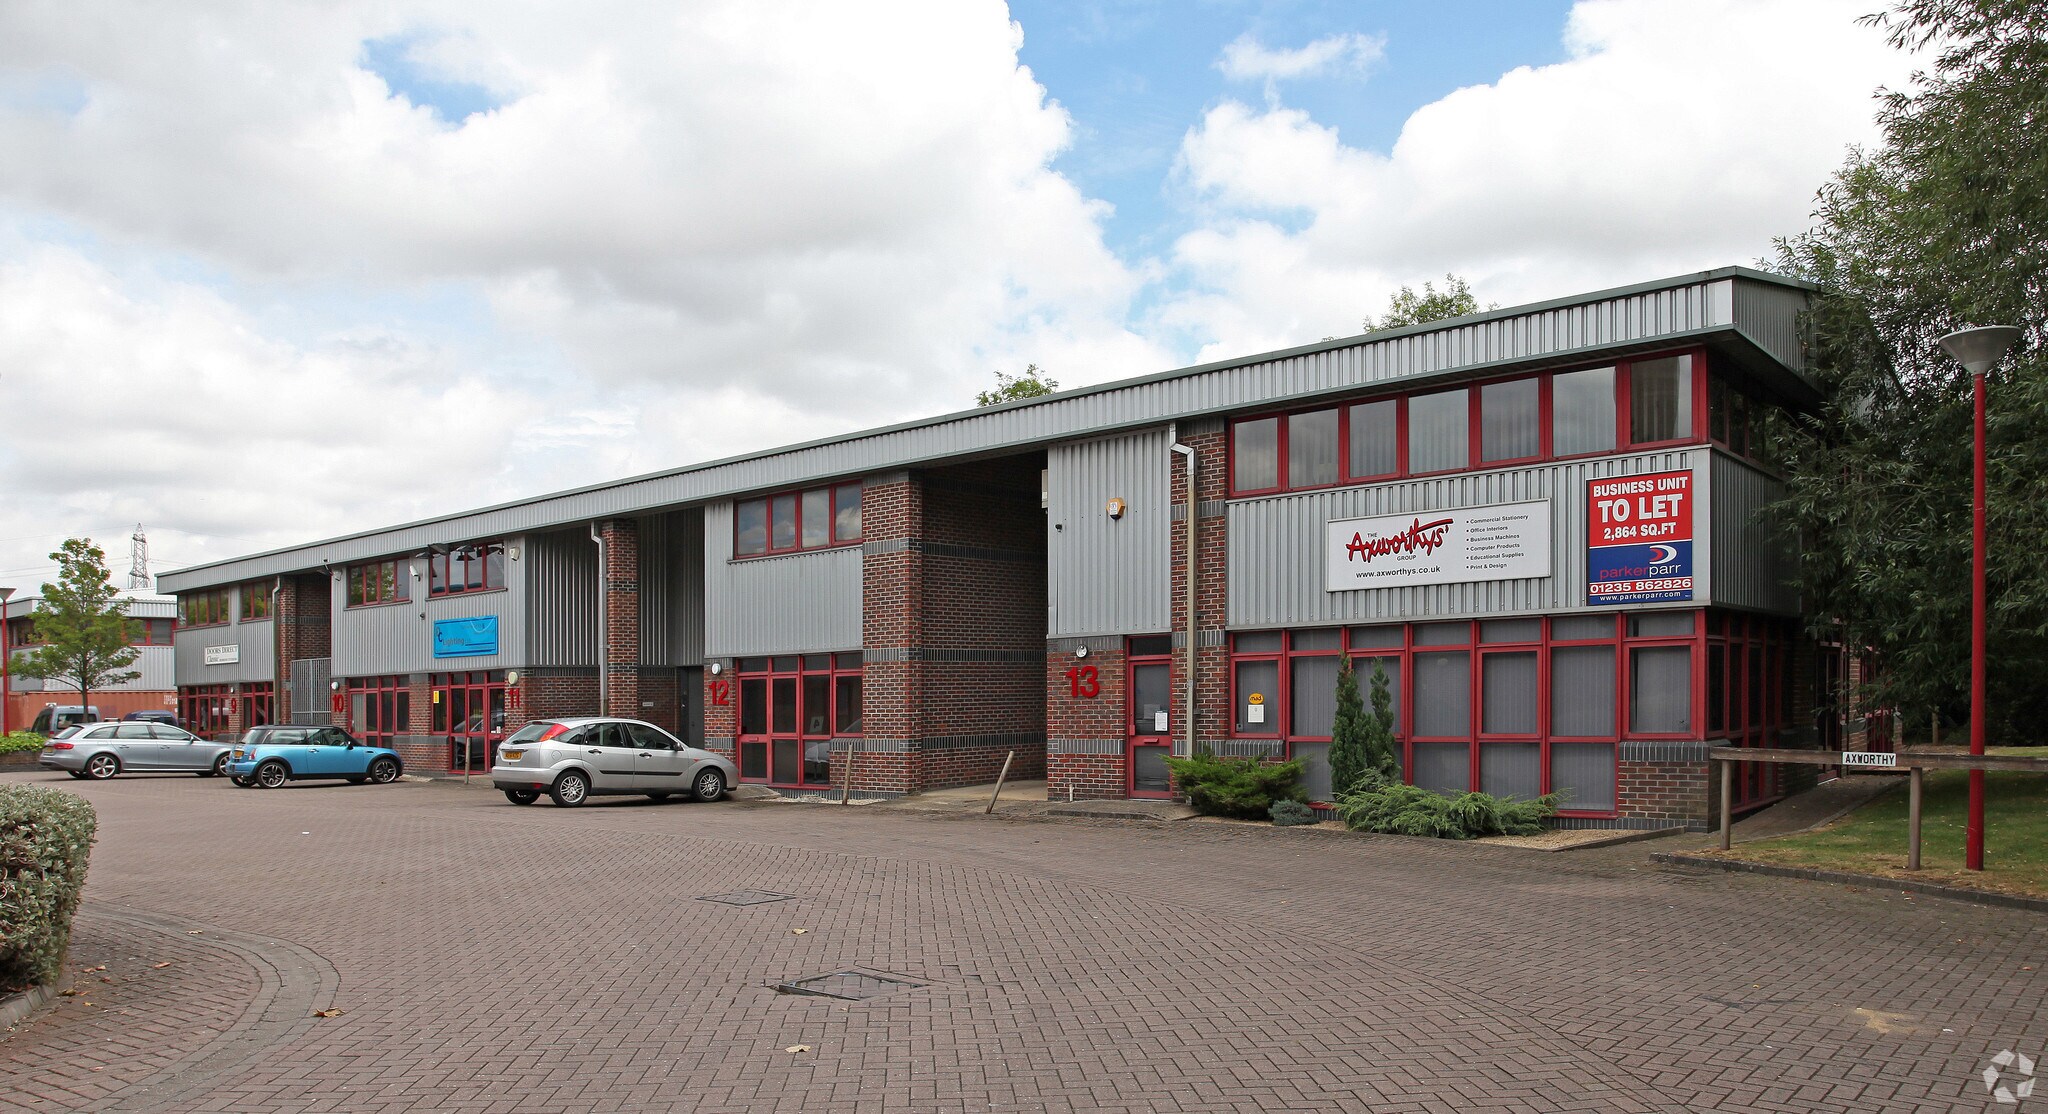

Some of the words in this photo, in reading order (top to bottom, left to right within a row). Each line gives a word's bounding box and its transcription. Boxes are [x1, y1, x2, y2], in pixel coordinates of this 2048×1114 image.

[1593, 480, 1654, 498] BUSINESS
[1657, 476, 1688, 491] UNIT
[1598, 498, 1631, 523] TO
[1638, 493, 1683, 520] LET
[1603, 526, 1637, 541] 2,864
[1640, 522, 1677, 537] SQ.FT
[1396, 554, 1417, 562] GROUP
[1355, 565, 1441, 579] www.axworthys.co.uk
[1590, 582, 1632, 594] 01235
[1635, 578, 1692, 591] 862826
[1600, 591, 1681, 601] www.parkerparr.com
[1065, 665, 1100, 698] 13
[508, 688, 520, 709] 11
[709, 680, 729, 705] 12
[231, 698, 237, 714] 9
[332, 694, 344, 713] 10
[1845, 753, 1895, 765] AXWORTHY
